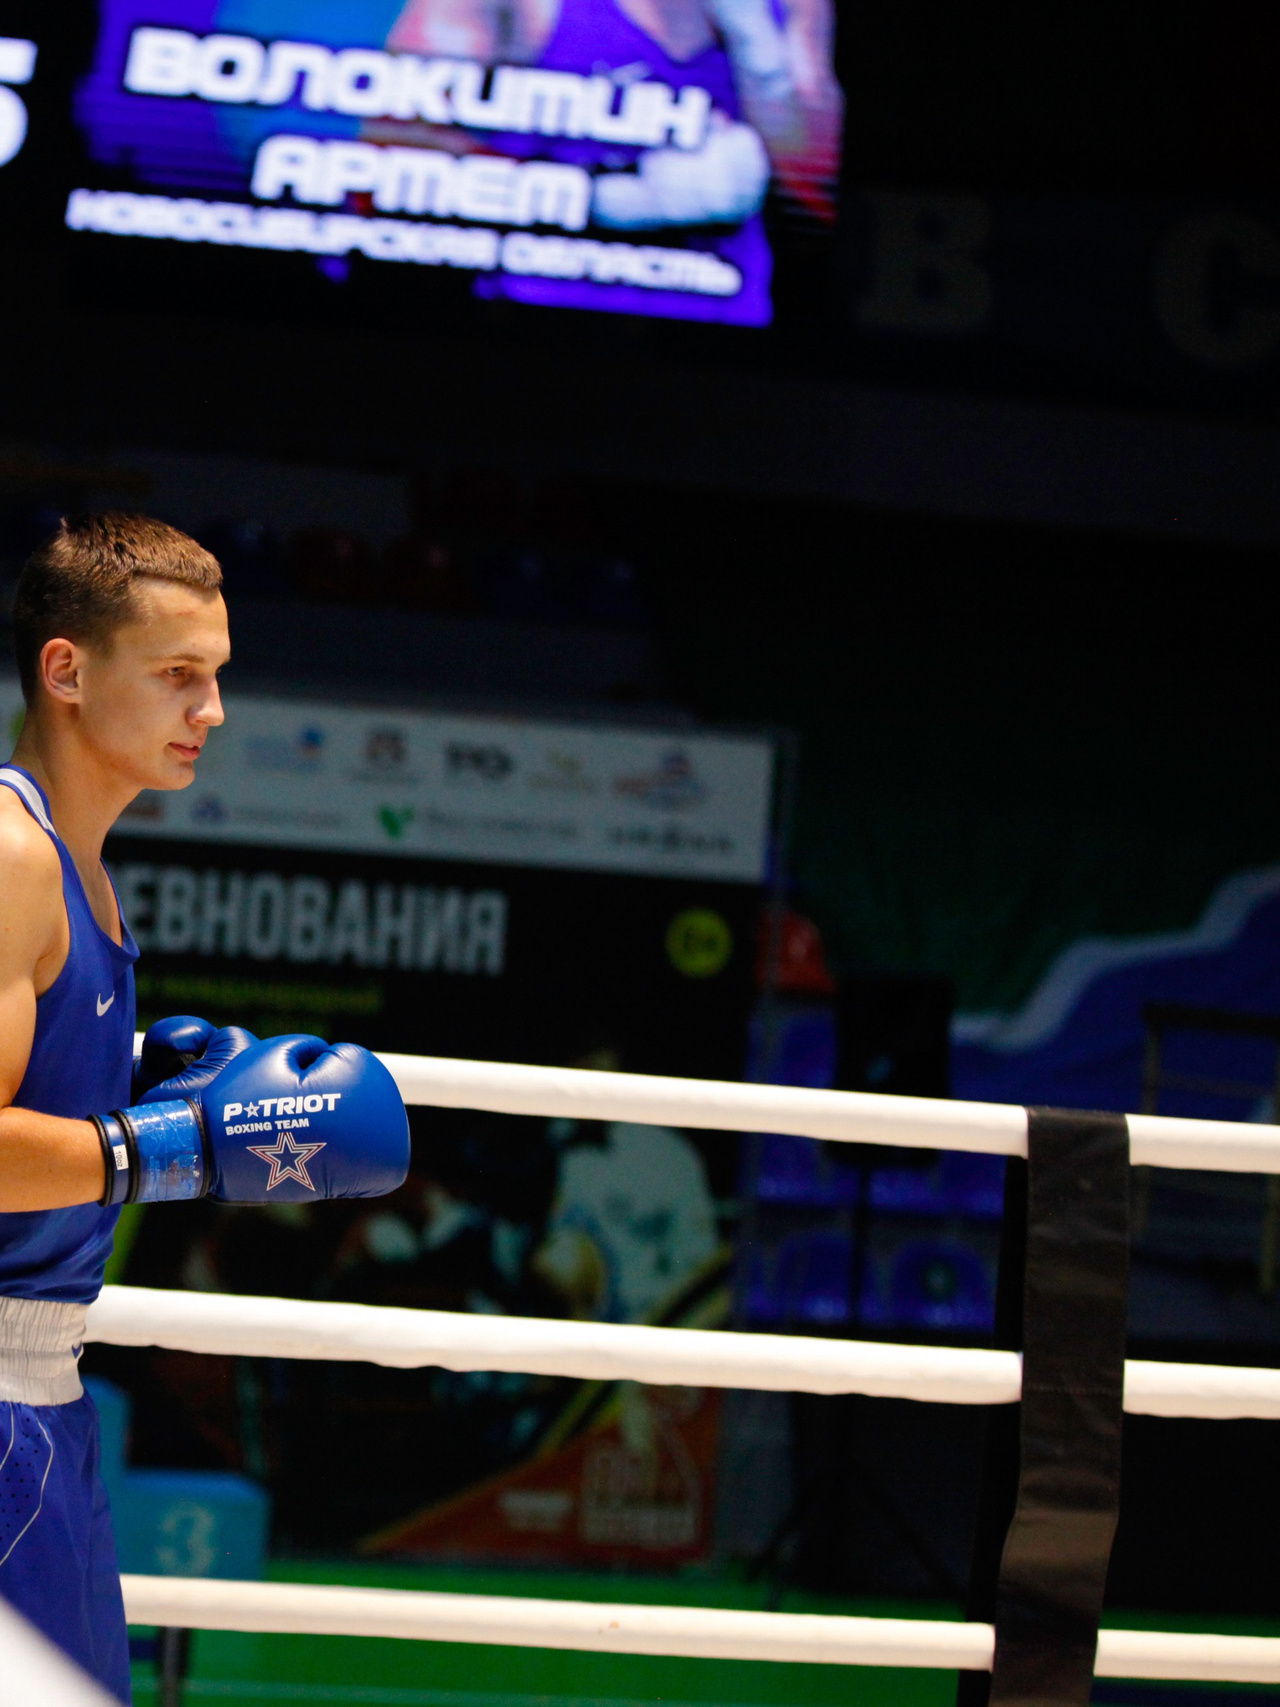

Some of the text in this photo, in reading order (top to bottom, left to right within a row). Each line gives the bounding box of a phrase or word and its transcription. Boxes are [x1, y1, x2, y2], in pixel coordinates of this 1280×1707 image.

[123, 26, 712, 149] ВОЛОКИТИН
[250, 133, 592, 231] АРТЕМ
[225, 1117, 310, 1136] BOXING TEAM
